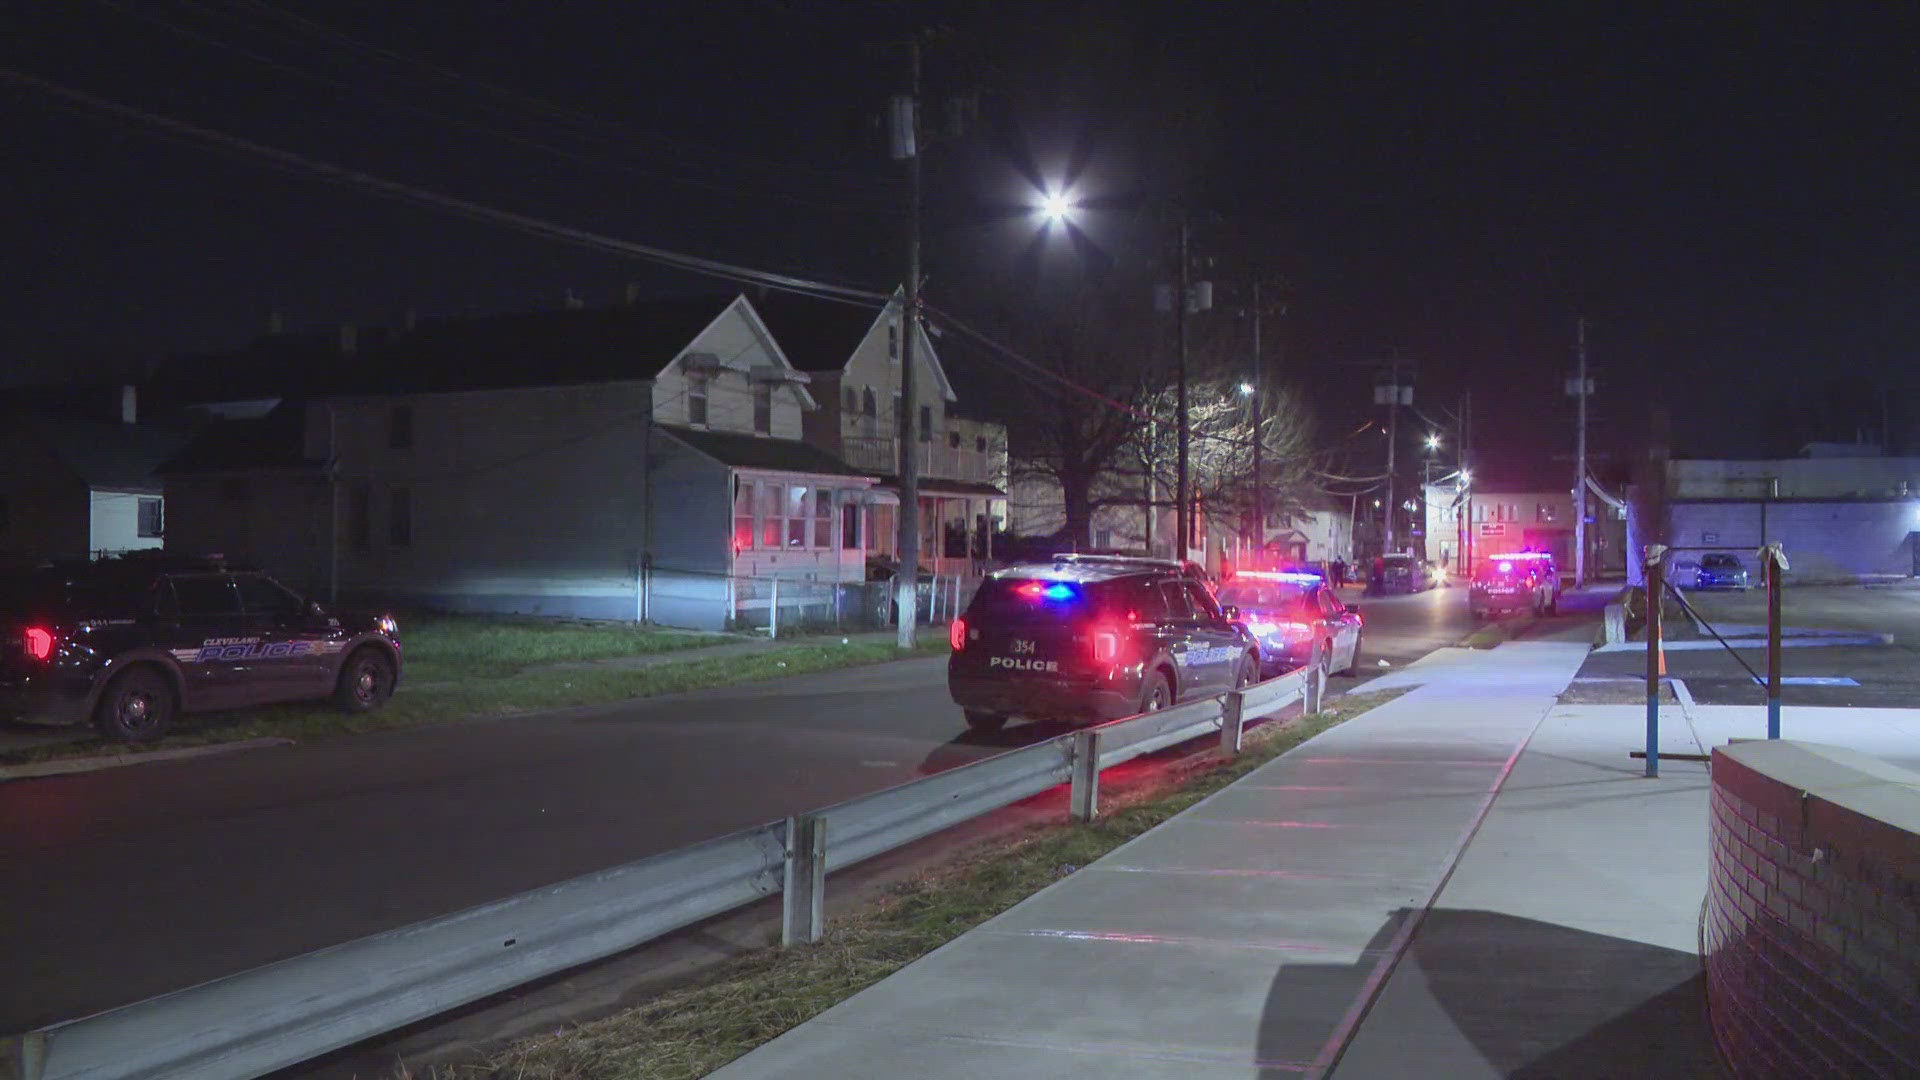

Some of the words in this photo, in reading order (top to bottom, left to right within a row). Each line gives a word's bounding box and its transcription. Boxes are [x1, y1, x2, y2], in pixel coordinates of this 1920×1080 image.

[203, 637, 261, 646] CLEVELAND
[1014, 639, 1037, 654] 354
[194, 642, 311, 664] POLICE
[990, 656, 1059, 672] POLICE
